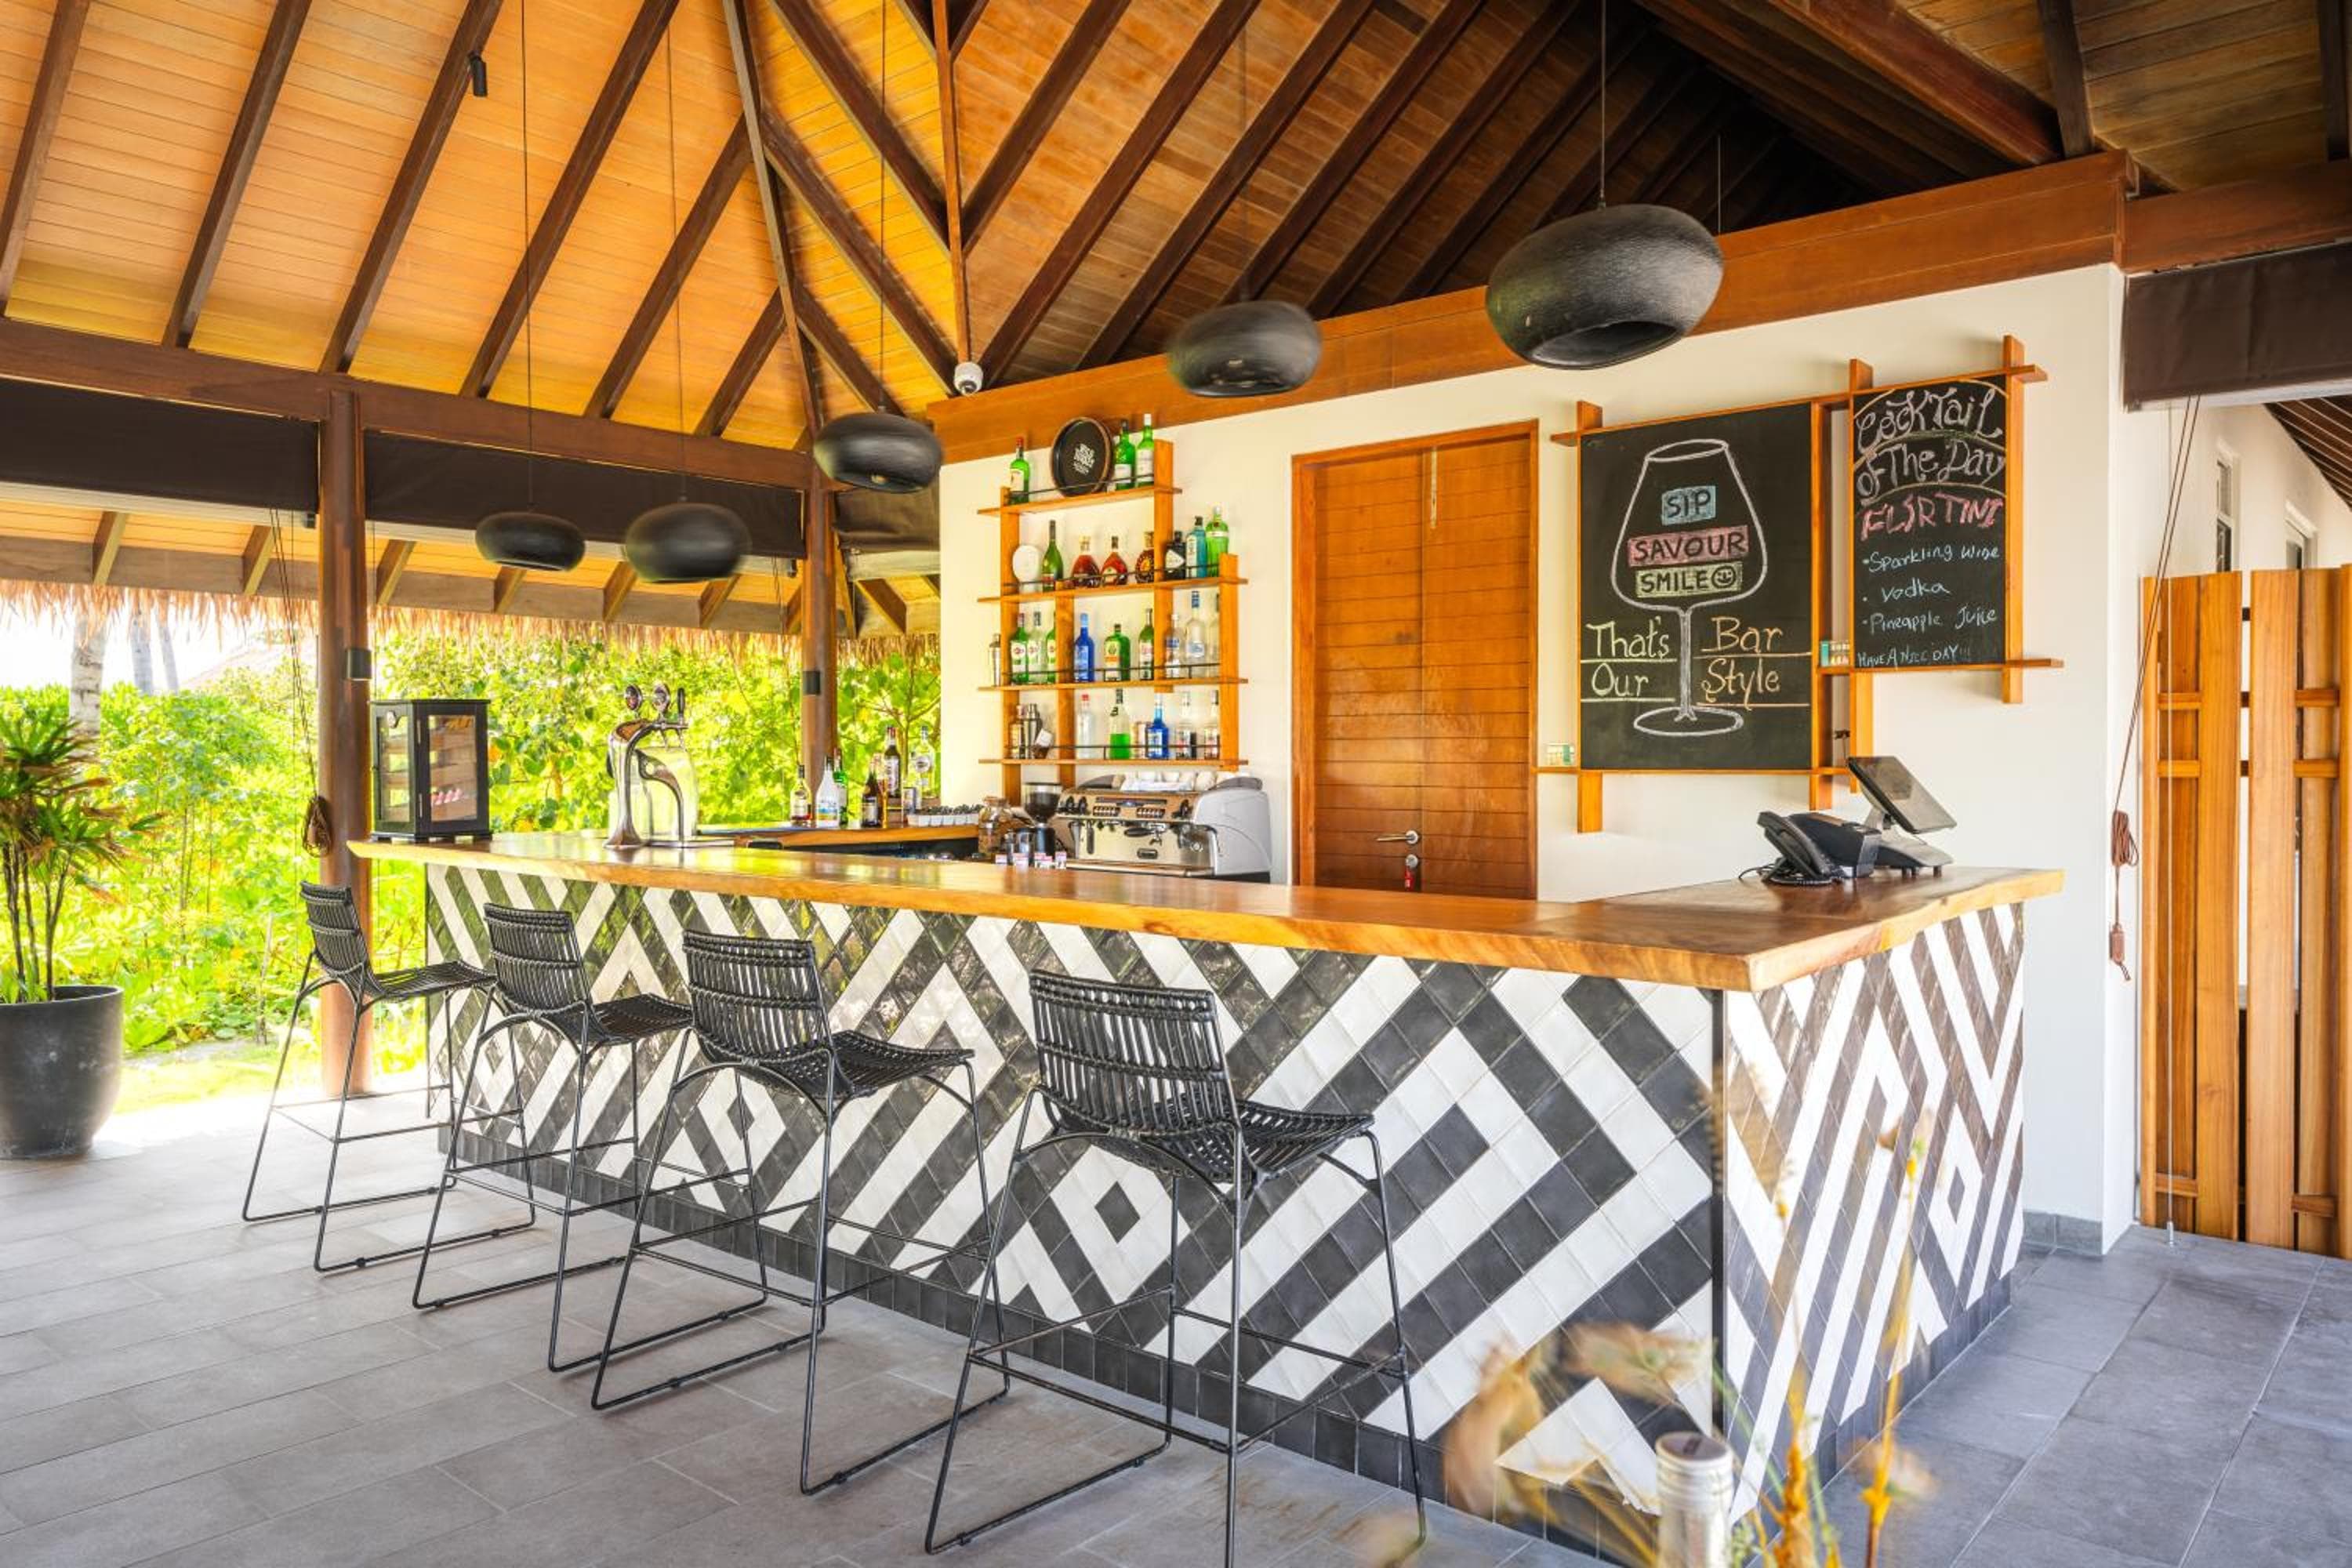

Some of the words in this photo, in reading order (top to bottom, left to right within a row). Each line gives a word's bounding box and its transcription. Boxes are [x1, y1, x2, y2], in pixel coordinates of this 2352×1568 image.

[1937, 438, 2005, 487] Day
[1667, 489, 1711, 518] SIP
[1633, 532, 1746, 561] SAVOUR
[1868, 544, 1954, 572] Sparkling
[1640, 570, 1710, 593] SMILE
[1870, 610, 1941, 634] Pineapple
[1955, 605, 1997, 630] Juice
[1586, 615, 1670, 659] That's
[1700, 616, 1784, 654] Bar
[1886, 647, 1898, 670] A
[1592, 662, 1650, 698] Our
[1700, 657, 1781, 712] Style
